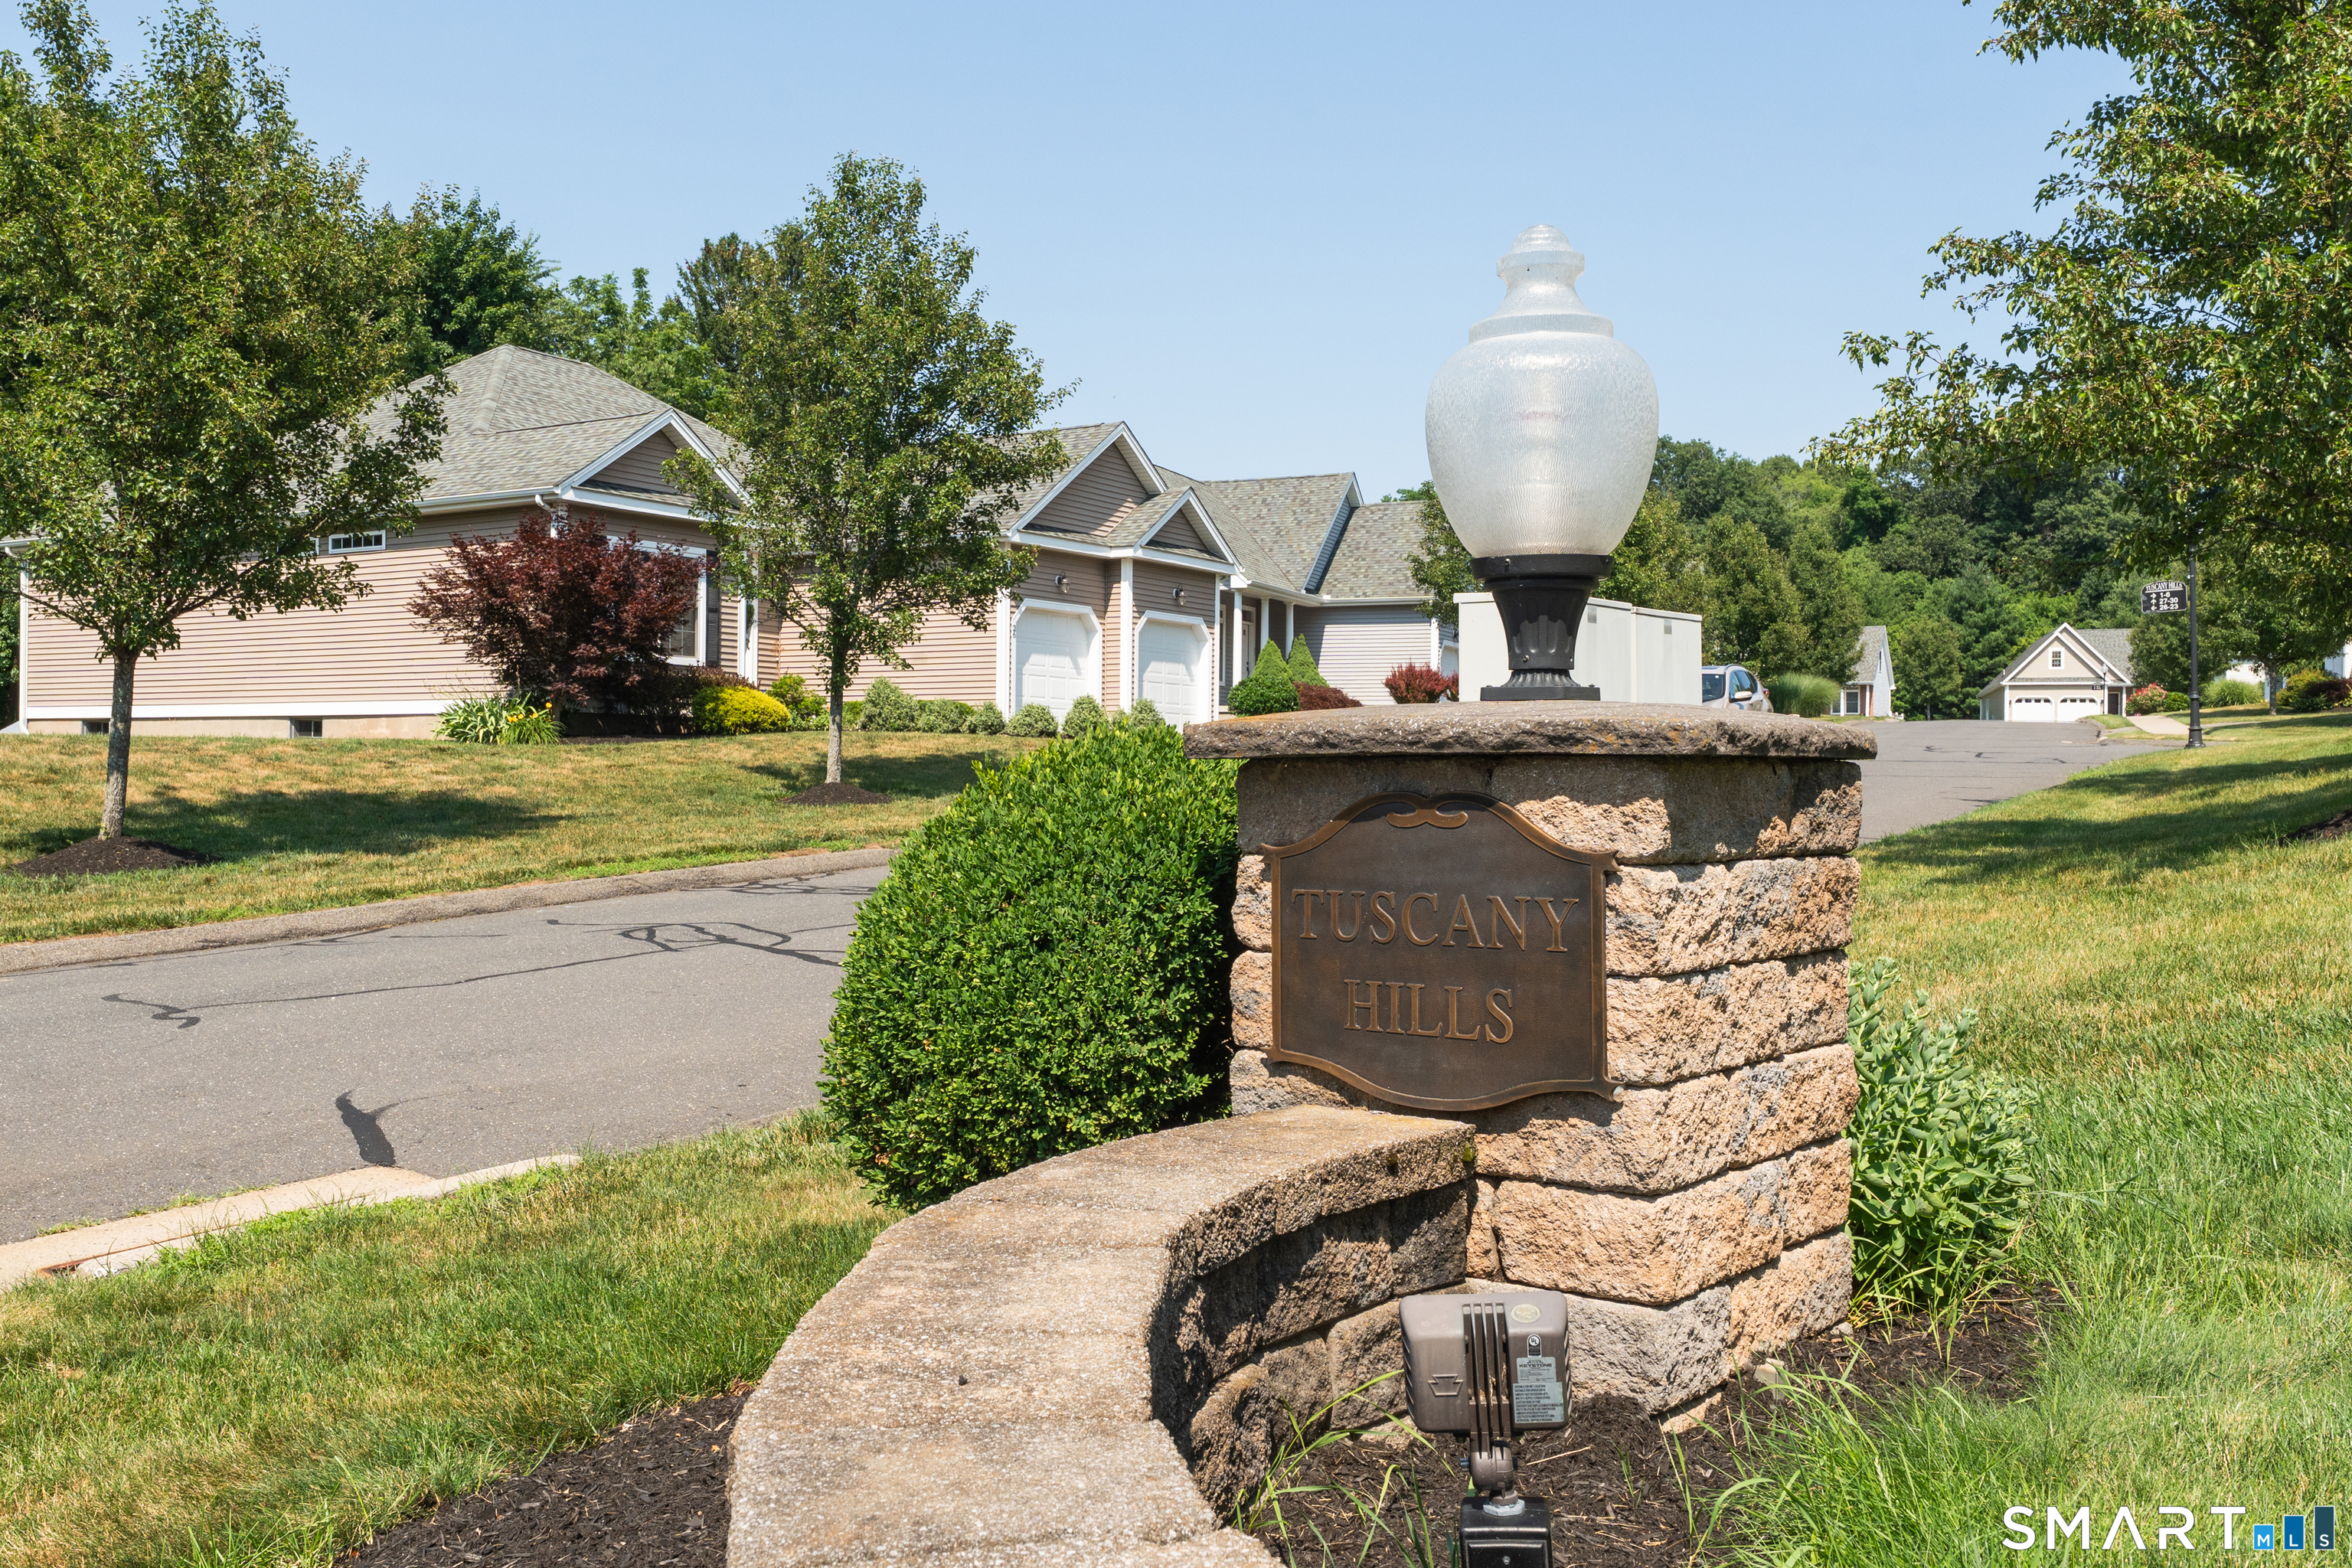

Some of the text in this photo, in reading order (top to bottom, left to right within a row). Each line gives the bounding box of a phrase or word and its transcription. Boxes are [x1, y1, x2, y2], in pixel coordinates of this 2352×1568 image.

[2146, 583, 2167, 591] TUSCANY
[1292, 889, 1579, 952] TUSCANY
[1344, 978, 1514, 1044] HILLS
